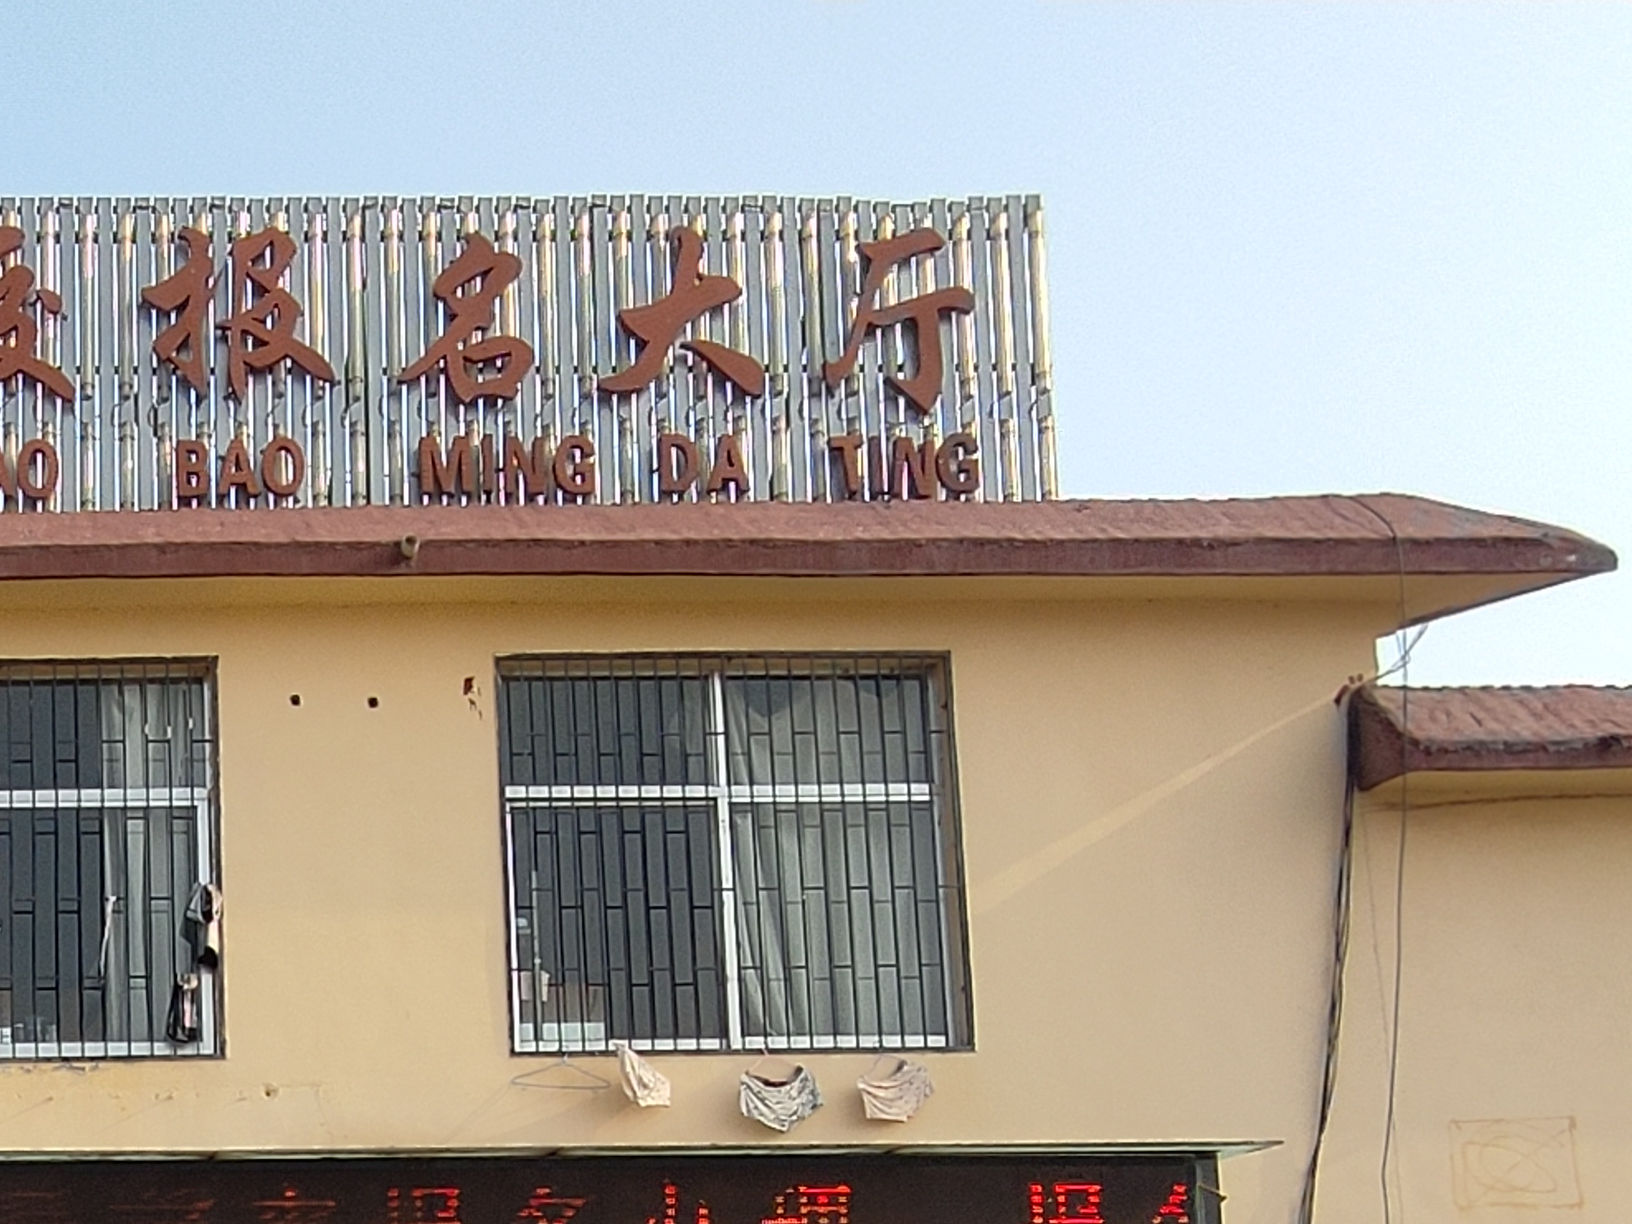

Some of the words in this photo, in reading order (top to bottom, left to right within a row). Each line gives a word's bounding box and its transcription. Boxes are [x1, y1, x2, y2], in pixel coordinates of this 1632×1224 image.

[174, 435, 305, 499] BAO
[418, 435, 597, 497] MING
[658, 434, 751, 497] DA
[831, 432, 981, 500] TING
